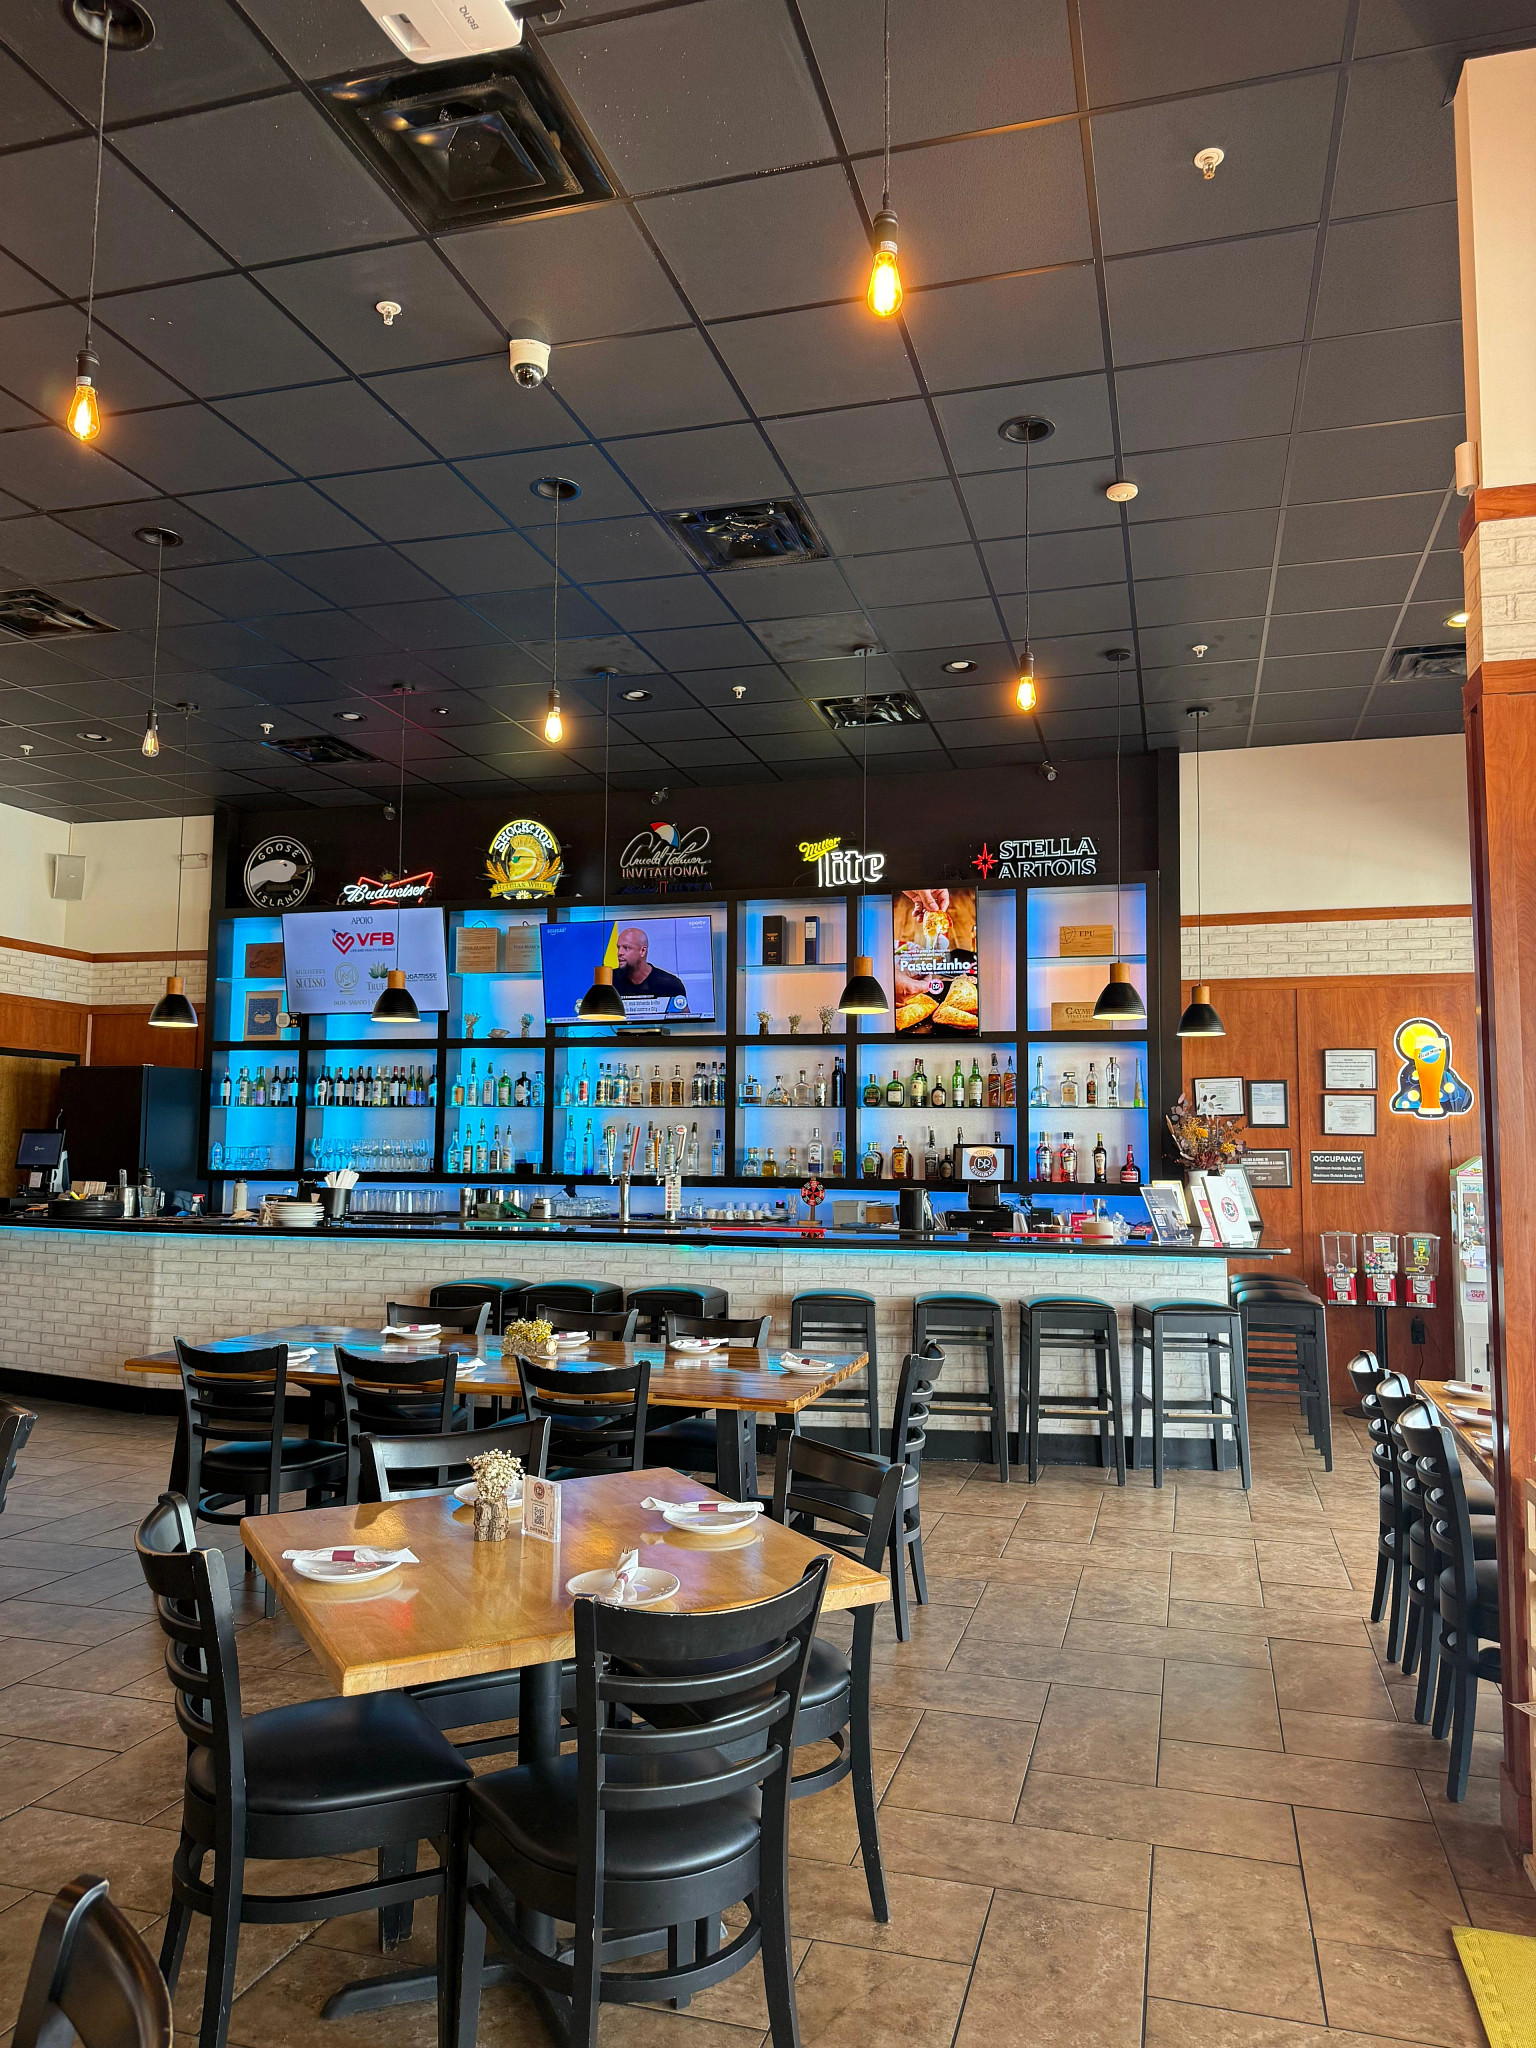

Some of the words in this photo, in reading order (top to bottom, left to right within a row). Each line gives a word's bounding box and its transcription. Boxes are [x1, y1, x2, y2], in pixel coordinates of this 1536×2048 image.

[258, 843, 300, 861] GOOSE
[798, 837, 841, 862] Miller
[999, 836, 1097, 860] STELLA
[622, 865, 708, 879] INVITATIONAL
[998, 858, 1097, 879] ARTOIS
[256, 888, 300, 907] ISLAND
[343, 883, 428, 902] Budweiser
[351, 916, 373, 925] APOIO
[356, 932, 395, 947] VFB
[900, 957, 970, 972] Pastelzinho
[295, 977, 326, 989] SUCESSO
